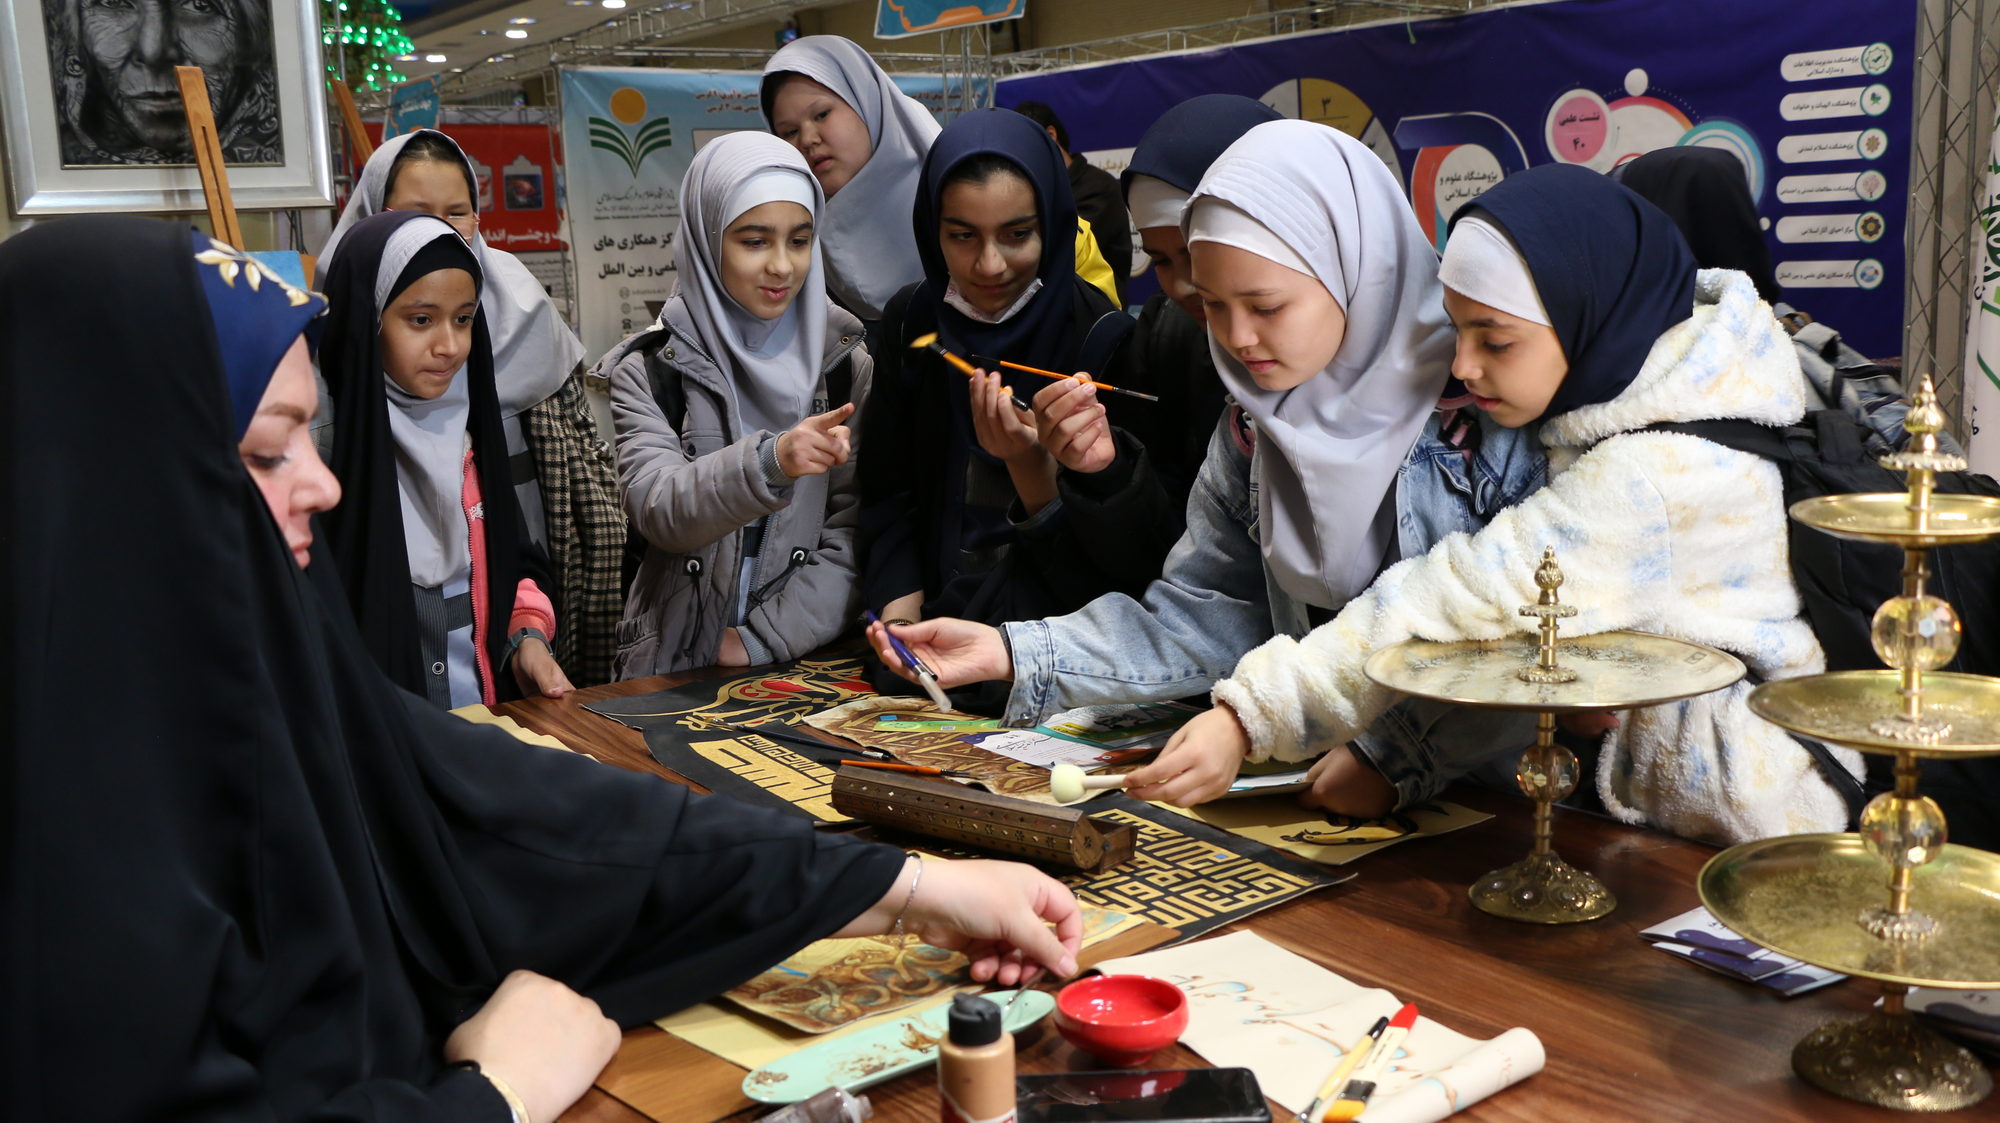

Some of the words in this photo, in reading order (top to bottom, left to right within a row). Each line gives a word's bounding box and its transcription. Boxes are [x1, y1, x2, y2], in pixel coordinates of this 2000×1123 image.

[1559, 113, 1577, 126] علمی
[1579, 111, 1600, 122] نشست
[1572, 137, 1586, 151] ۴۰
[1445, 171, 1461, 184] علوم
[1445, 187, 1470, 201] اسلامی
[593, 234, 616, 251] های
[617, 233, 658, 250] همکاری
[598, 262, 626, 279] الملل
[627, 265, 645, 277] بین
[647, 265, 654, 277] و
